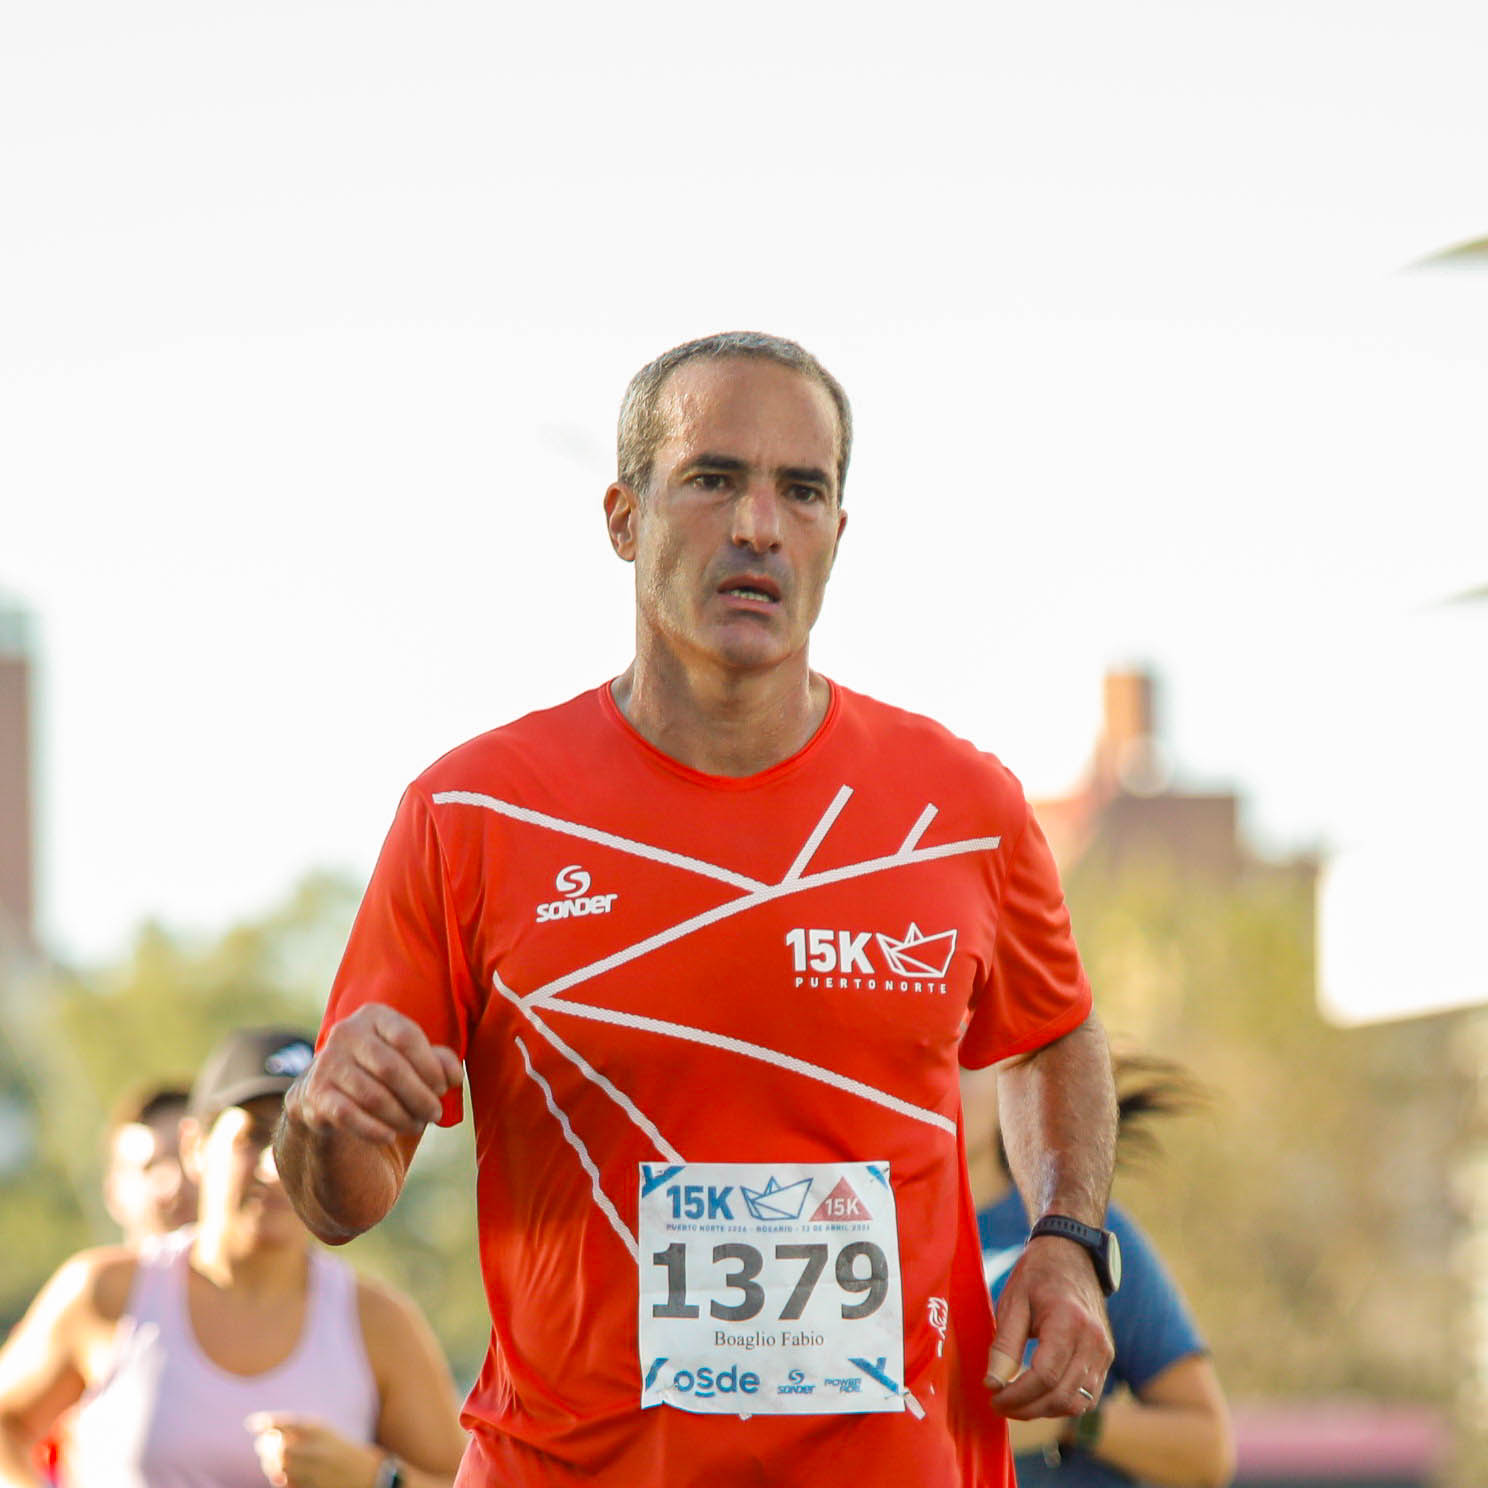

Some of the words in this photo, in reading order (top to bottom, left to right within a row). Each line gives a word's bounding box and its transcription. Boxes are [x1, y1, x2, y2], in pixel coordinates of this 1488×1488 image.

[785, 928, 875, 974] 15K
[795, 977, 876, 990] PUERTO
[885, 980, 947, 994] NORTE
[666, 1184, 735, 1221] 15K
[824, 1198, 860, 1216] 15K
[652, 1241, 889, 1322] 1379
[714, 1330, 776, 1350] Boaglio
[780, 1330, 825, 1347] Fabio
[673, 1364, 761, 1394] osde
